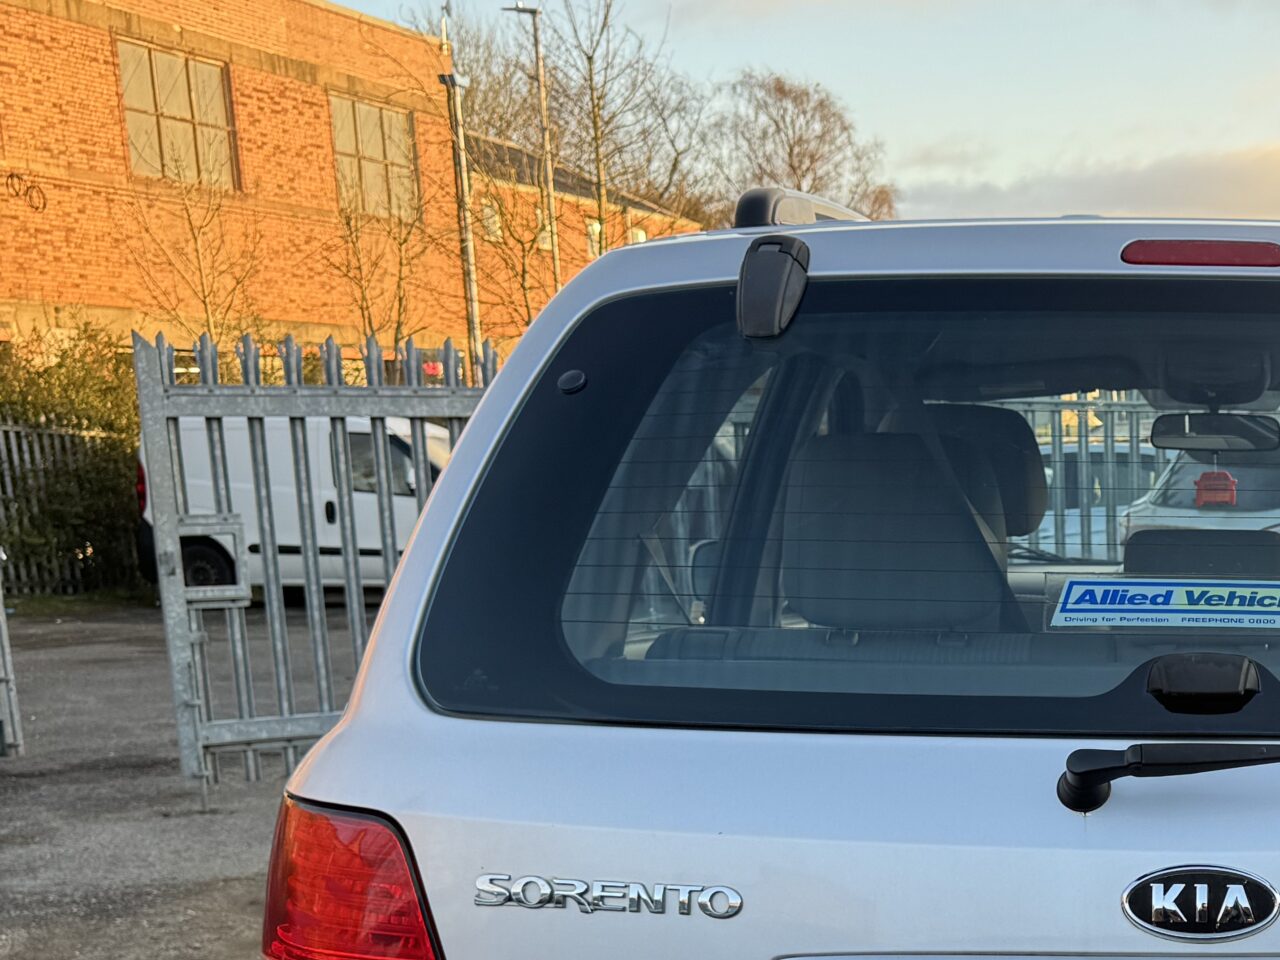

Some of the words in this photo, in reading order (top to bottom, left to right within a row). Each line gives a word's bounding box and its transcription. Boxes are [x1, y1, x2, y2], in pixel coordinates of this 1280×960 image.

[1072, 588, 1174, 606] Allied
[474, 873, 743, 919] SORENTO
[1150, 883, 1256, 925] KIA
